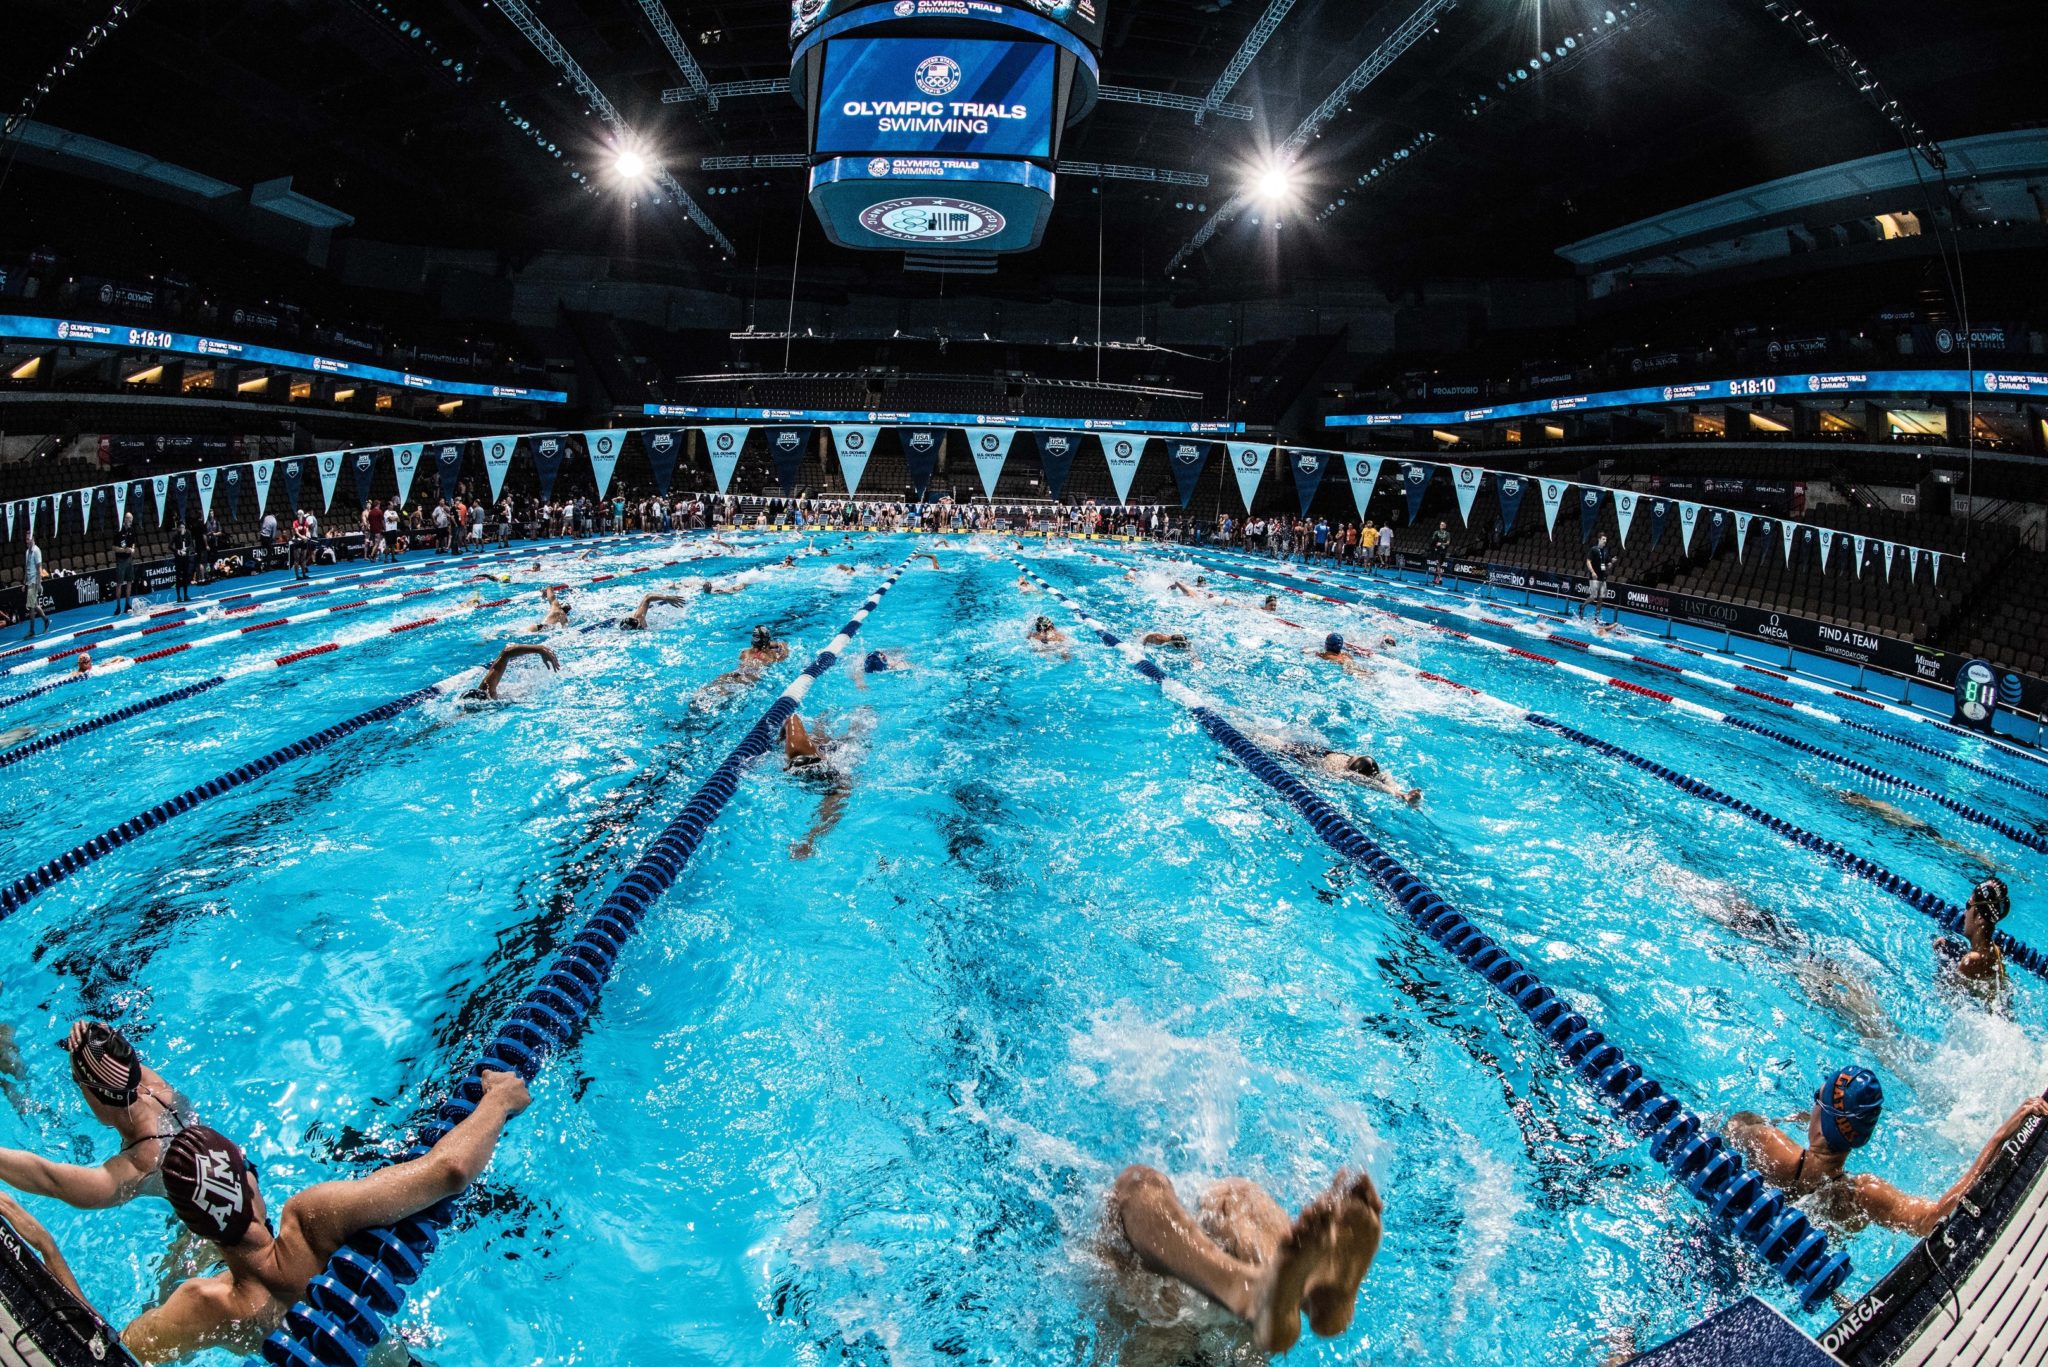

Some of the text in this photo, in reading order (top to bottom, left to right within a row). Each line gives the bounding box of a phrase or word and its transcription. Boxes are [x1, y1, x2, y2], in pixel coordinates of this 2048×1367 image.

[917, 7, 969, 15] SWIMMING
[918, 0, 1003, 14] OLYMPIC TRIALS
[843, 101, 1027, 119] OLYMPIC TRIALS
[878, 118, 988, 134] SWIMMING
[892, 160, 980, 170] OLYMPIC TRIALS
[892, 168, 945, 176] SWIMMING
[868, 200, 918, 240] OLYMPIC TEAM
[959, 203, 998, 223] UNITED
[129, 329, 172, 349] 9:18:10
[1970, 332, 2005, 342] OLYMPIC
[1821, 374, 1867, 383] OLYMPIC TRIALS
[1998, 375, 2048, 385] OLYMPIC TRIALS
[1729, 378, 1776, 396] 9:18:10
[1999, 383, 2030, 391] SWIMMING
[1902, 495, 1915, 504] 106
[1957, 501, 1968, 510] 107
[1460, 564, 1473, 574] NBC
[151, 575, 178, 588] @TEAMUS
[1512, 576, 1525, 586] RIO
[39, 596, 55, 607] EGA
[1628, 591, 1649, 603] OMAHA
[1685, 600, 1708, 615] LAST
[1709, 604, 1738, 622] GOLD
[1758, 624, 1789, 640] OMEGA
[1819, 626, 1879, 651] FIND A TEAM
[1915, 654, 1941, 670] Minute
[1917, 664, 1936, 678] Maid
[2017, 1114, 2042, 1144] OMEGA
[0, 1226, 21, 1261] EGA
[1824, 1295, 1886, 1353] OMEGA
